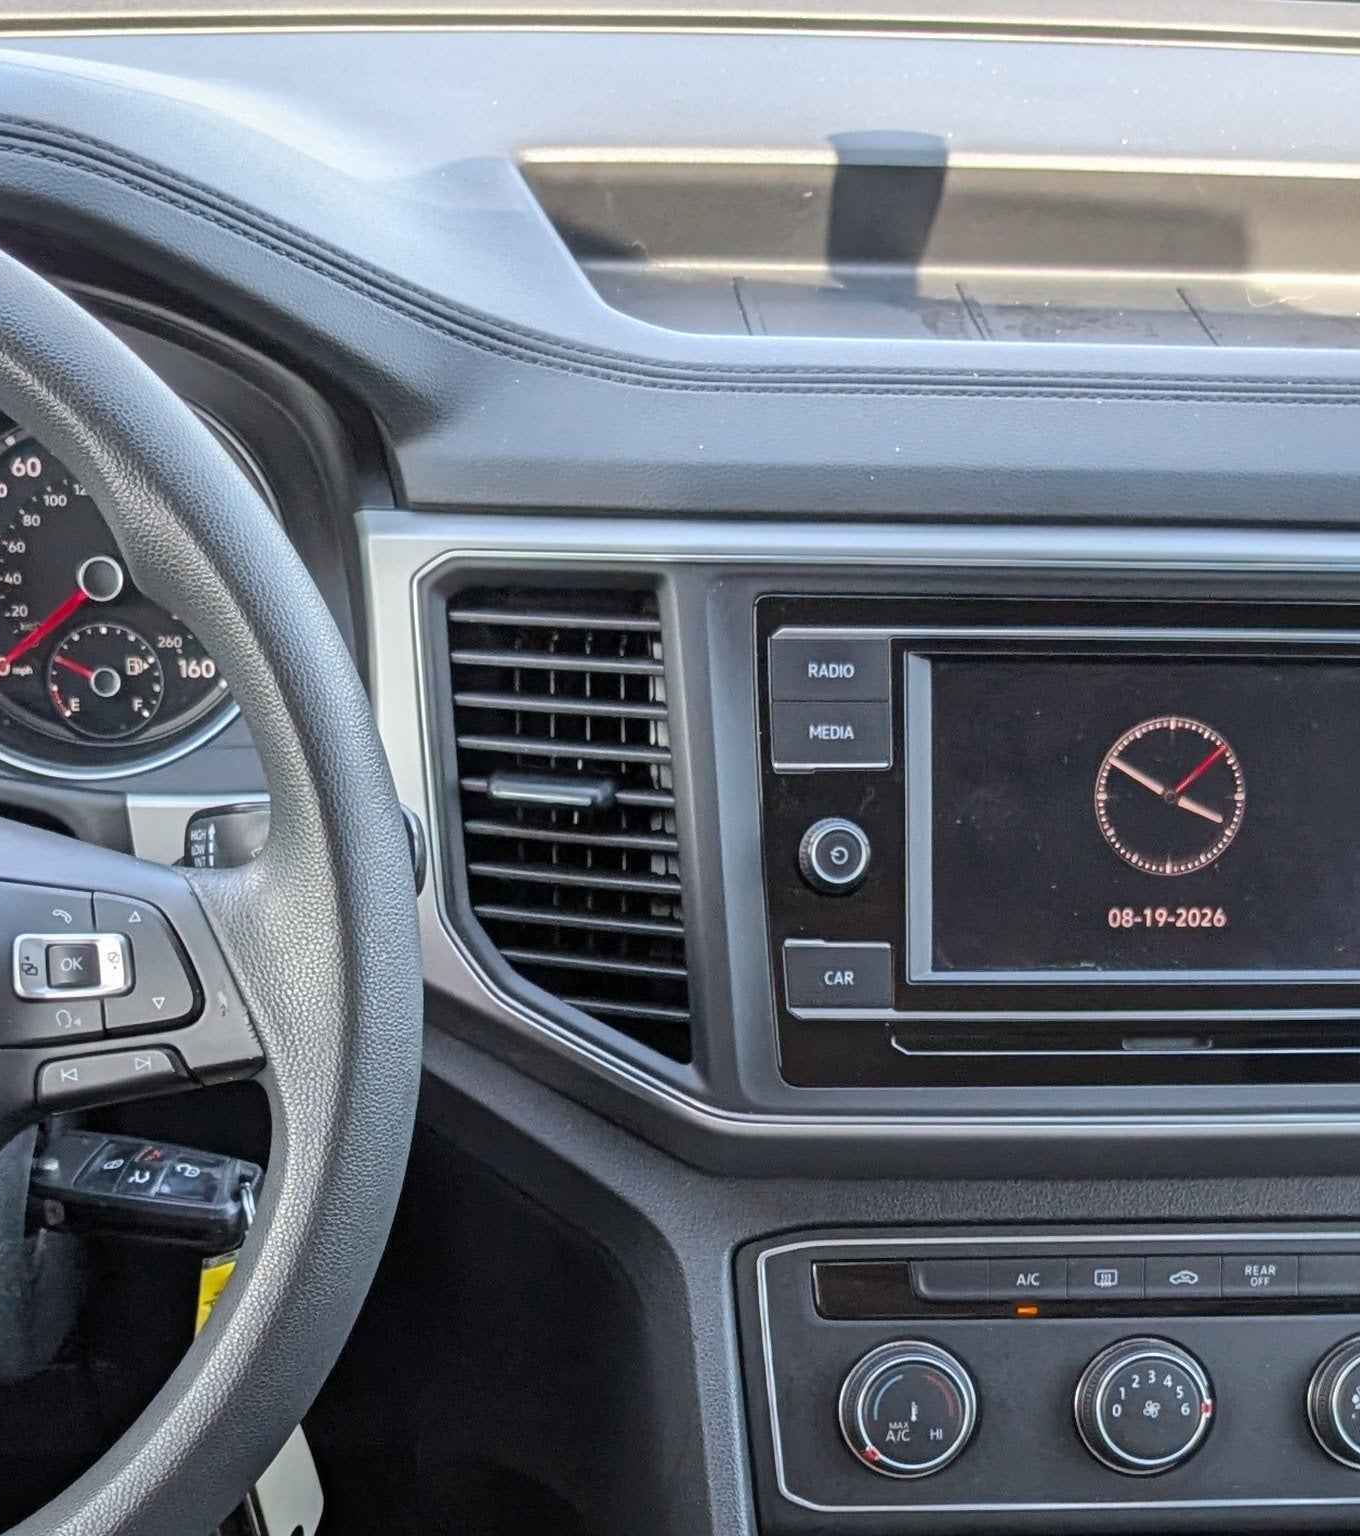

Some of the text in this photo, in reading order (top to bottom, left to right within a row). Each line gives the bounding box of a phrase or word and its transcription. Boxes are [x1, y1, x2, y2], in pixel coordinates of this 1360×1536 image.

[11, 457, 42, 478] 60
[43, 495, 68, 507] 100
[22, 514, 41, 527] 80
[7, 541, 26, 554] 60
[4, 573, 22, 585] 40
[11, 605, 28, 617] 20
[157, 636, 183, 648] 260
[12, 665, 33, 676] mph
[177, 658, 216, 679] 160
[807, 662, 856, 679] RADIO
[69, 699, 81, 713] E
[131, 699, 143, 713] F
[808, 723, 856, 740] MEDIA
[1107, 906, 1228, 928] 08-19-2026
[60, 955, 84, 974] OK
[823, 970, 855, 986] CAR
[1244, 1264, 1277, 1277] REAR
[1015, 1271, 1040, 1287] A/C
[1249, 1276, 1271, 1288] OFF
[1131, 1374, 1141, 1389] 2
[1147, 1369, 1157, 1384] 3
[1162, 1374, 1173, 1388] 4
[1118, 1386, 1126, 1400] 1
[1175, 1385, 1185, 1400] 5
[1111, 1403, 1122, 1418] 0
[1180, 1402, 1191, 1417] 6
[887, 1421, 910, 1430] MAX
[885, 1429, 911, 1444] A/C
[928, 1427, 944, 1442] HI
